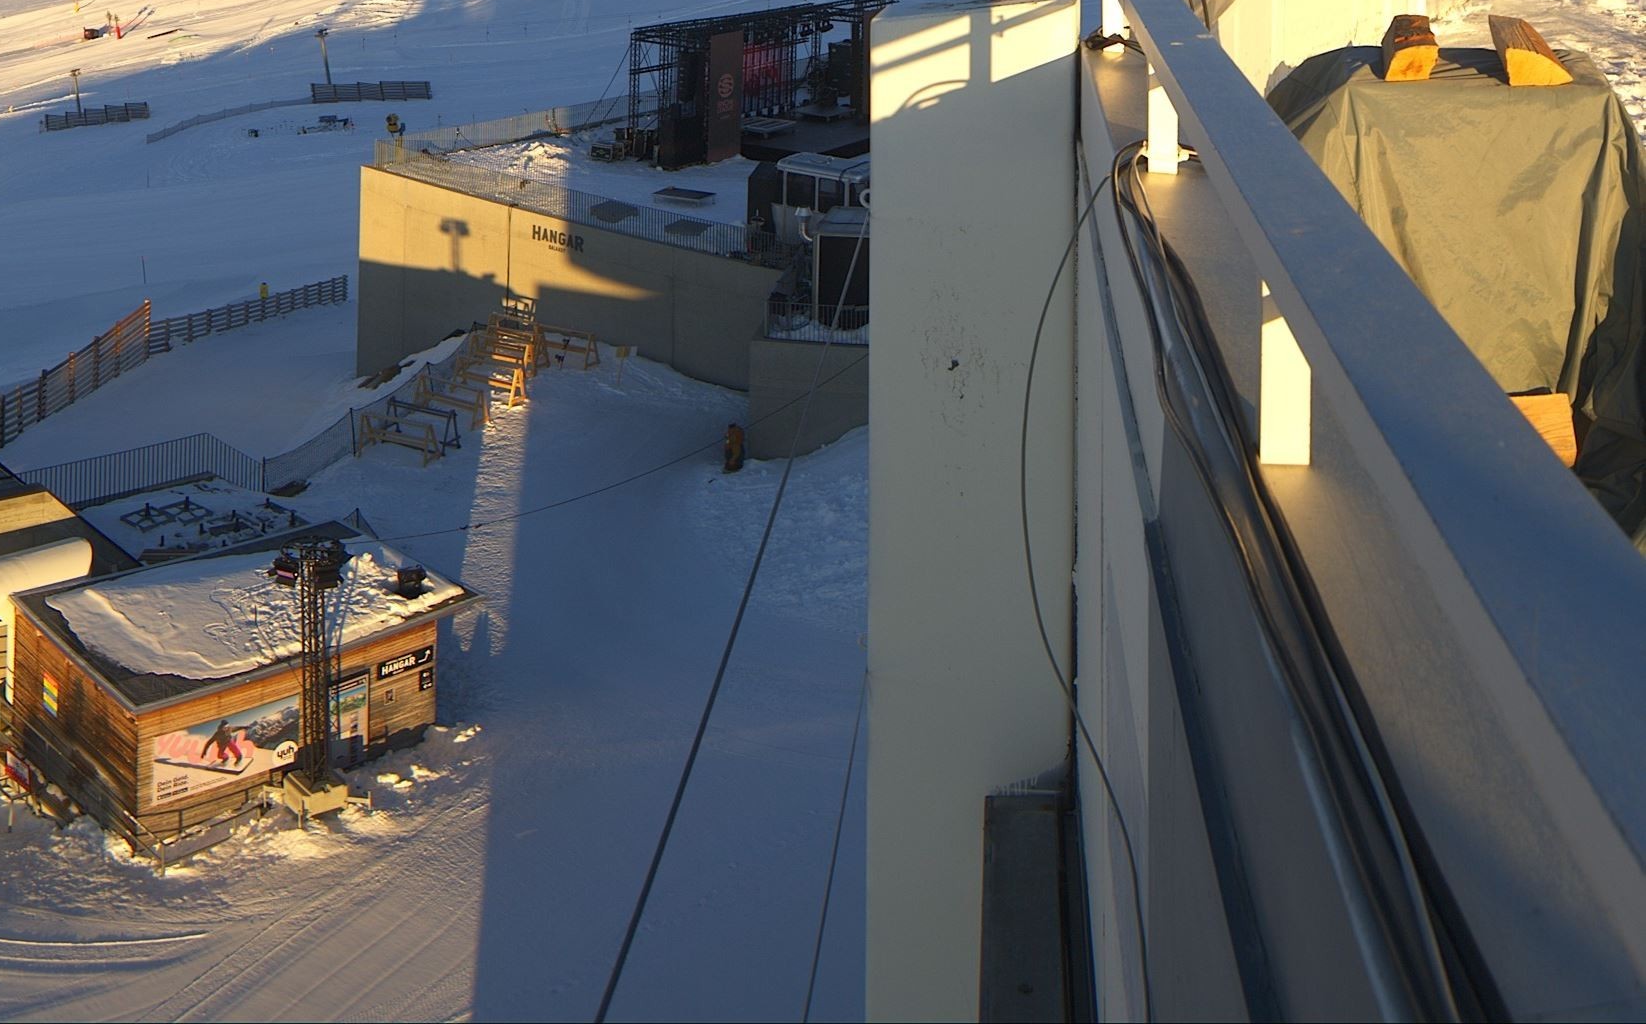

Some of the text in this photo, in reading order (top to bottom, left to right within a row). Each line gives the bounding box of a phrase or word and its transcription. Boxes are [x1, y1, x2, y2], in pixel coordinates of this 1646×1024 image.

[532, 225, 584, 253] HANGAR
[381, 656, 416, 676] HANGAR
[277, 745, 295, 759] yuh
